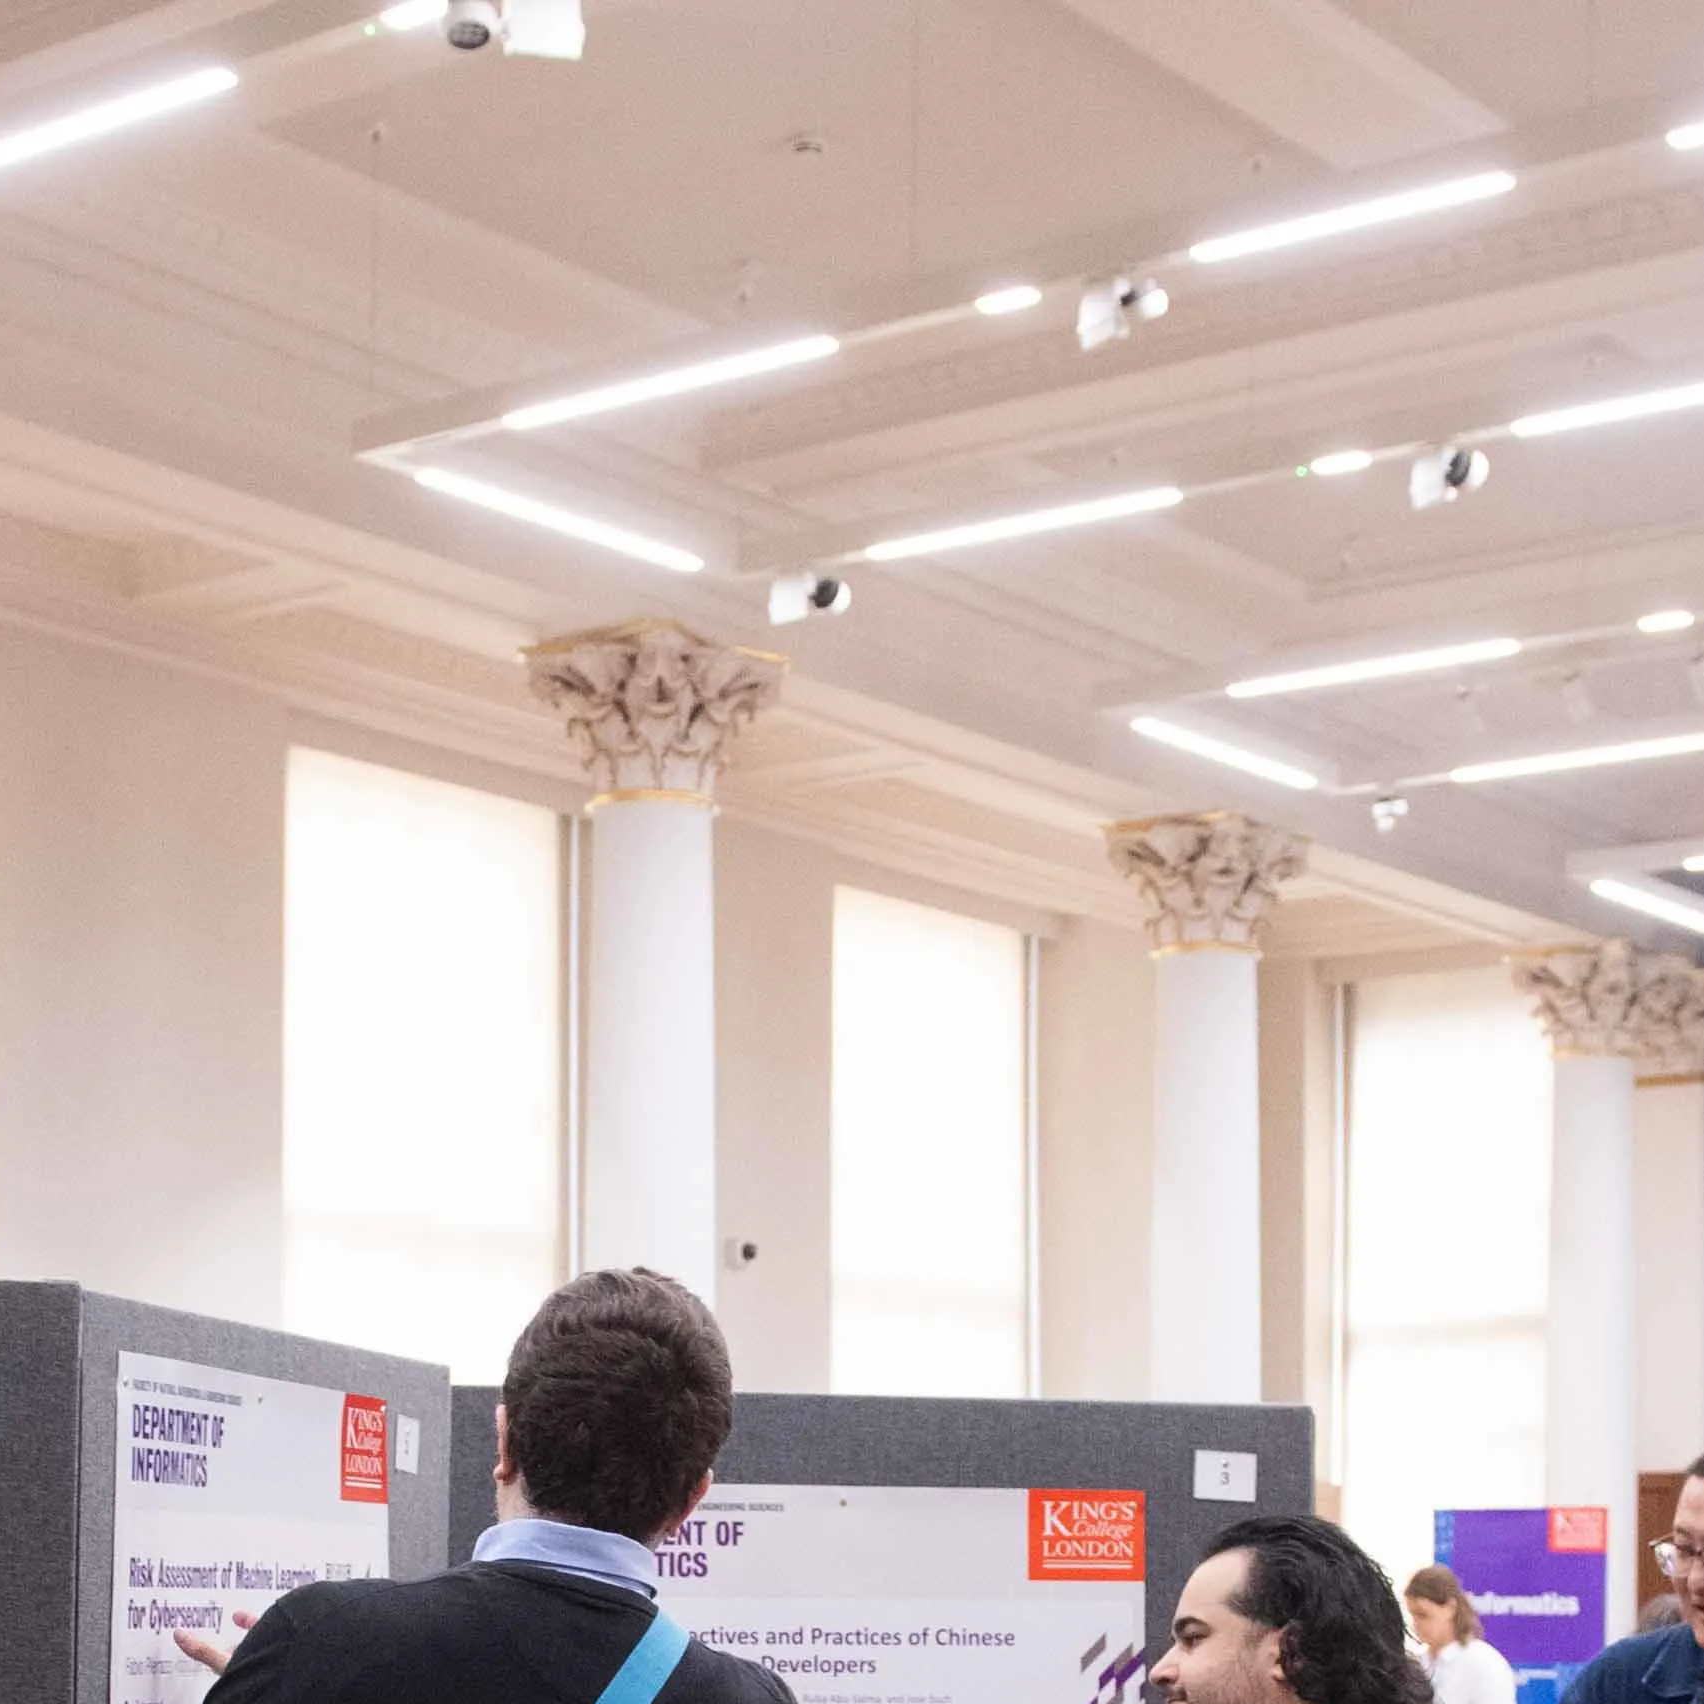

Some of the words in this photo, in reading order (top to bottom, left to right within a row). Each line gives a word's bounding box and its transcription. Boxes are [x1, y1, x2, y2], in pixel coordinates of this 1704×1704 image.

[133, 1405, 209, 1446] DEPARTMENT
[212, 1415, 224, 1449] OF
[132, 1447, 207, 1487] INFORMATICS
[344, 1454, 383, 1476] LONDON
[1220, 1472, 1230, 1485] 3
[716, 1522, 744, 1547] OF
[1072, 1520, 1135, 1540] College
[1043, 1541, 1134, 1558] LONDON
[129, 1556, 154, 1589] Risk
[157, 1558, 218, 1589] Assessment
[221, 1561, 232, 1590] of
[236, 1561, 273, 1590] Machine
[128, 1599, 146, 1630] for
[149, 1600, 223, 1634] Cybersecurity
[766, 1627, 803, 1646] and
[811, 1627, 901, 1646] Practices
[908, 1627, 928, 1646] of
[935, 1628, 1016, 1648] Chinese
[761, 1655, 877, 1677] Developers
